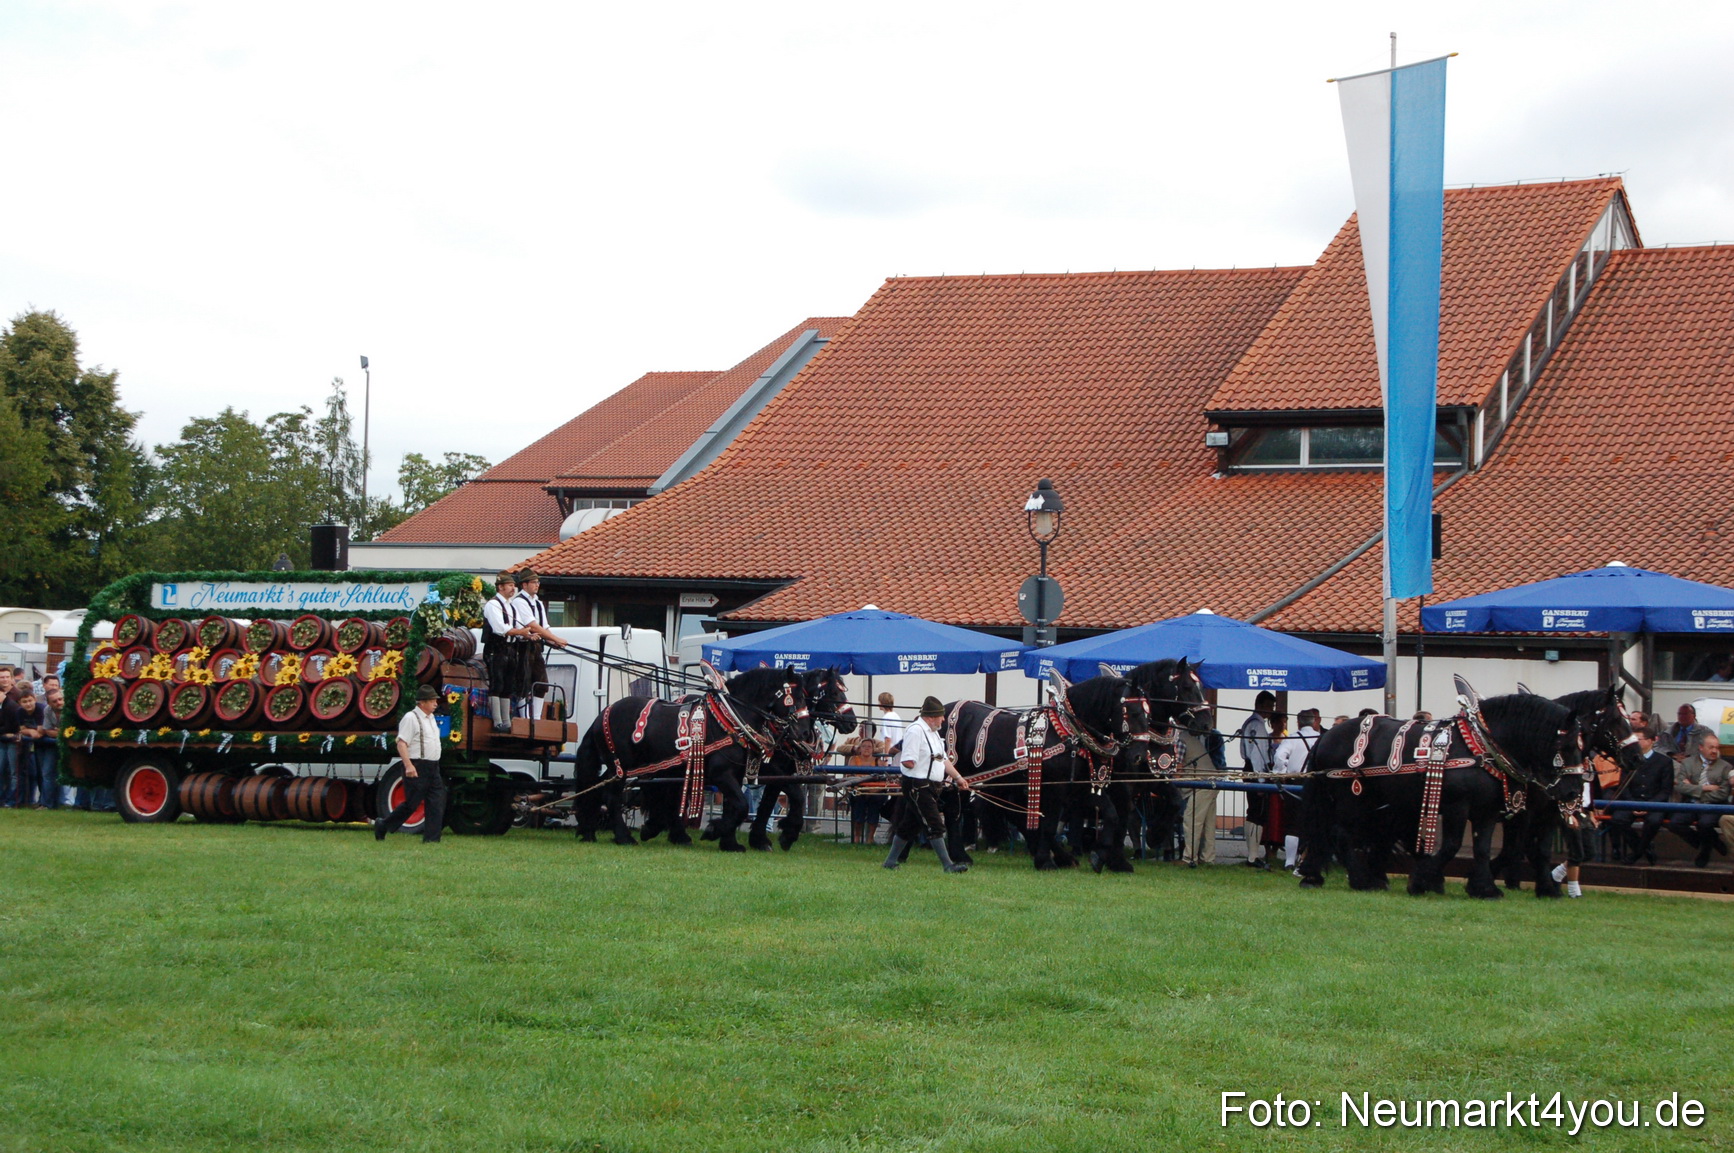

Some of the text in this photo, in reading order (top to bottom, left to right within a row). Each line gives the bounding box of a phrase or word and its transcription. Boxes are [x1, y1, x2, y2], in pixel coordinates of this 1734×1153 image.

[191, 581, 415, 609] Neumarkt's guter Schluck
